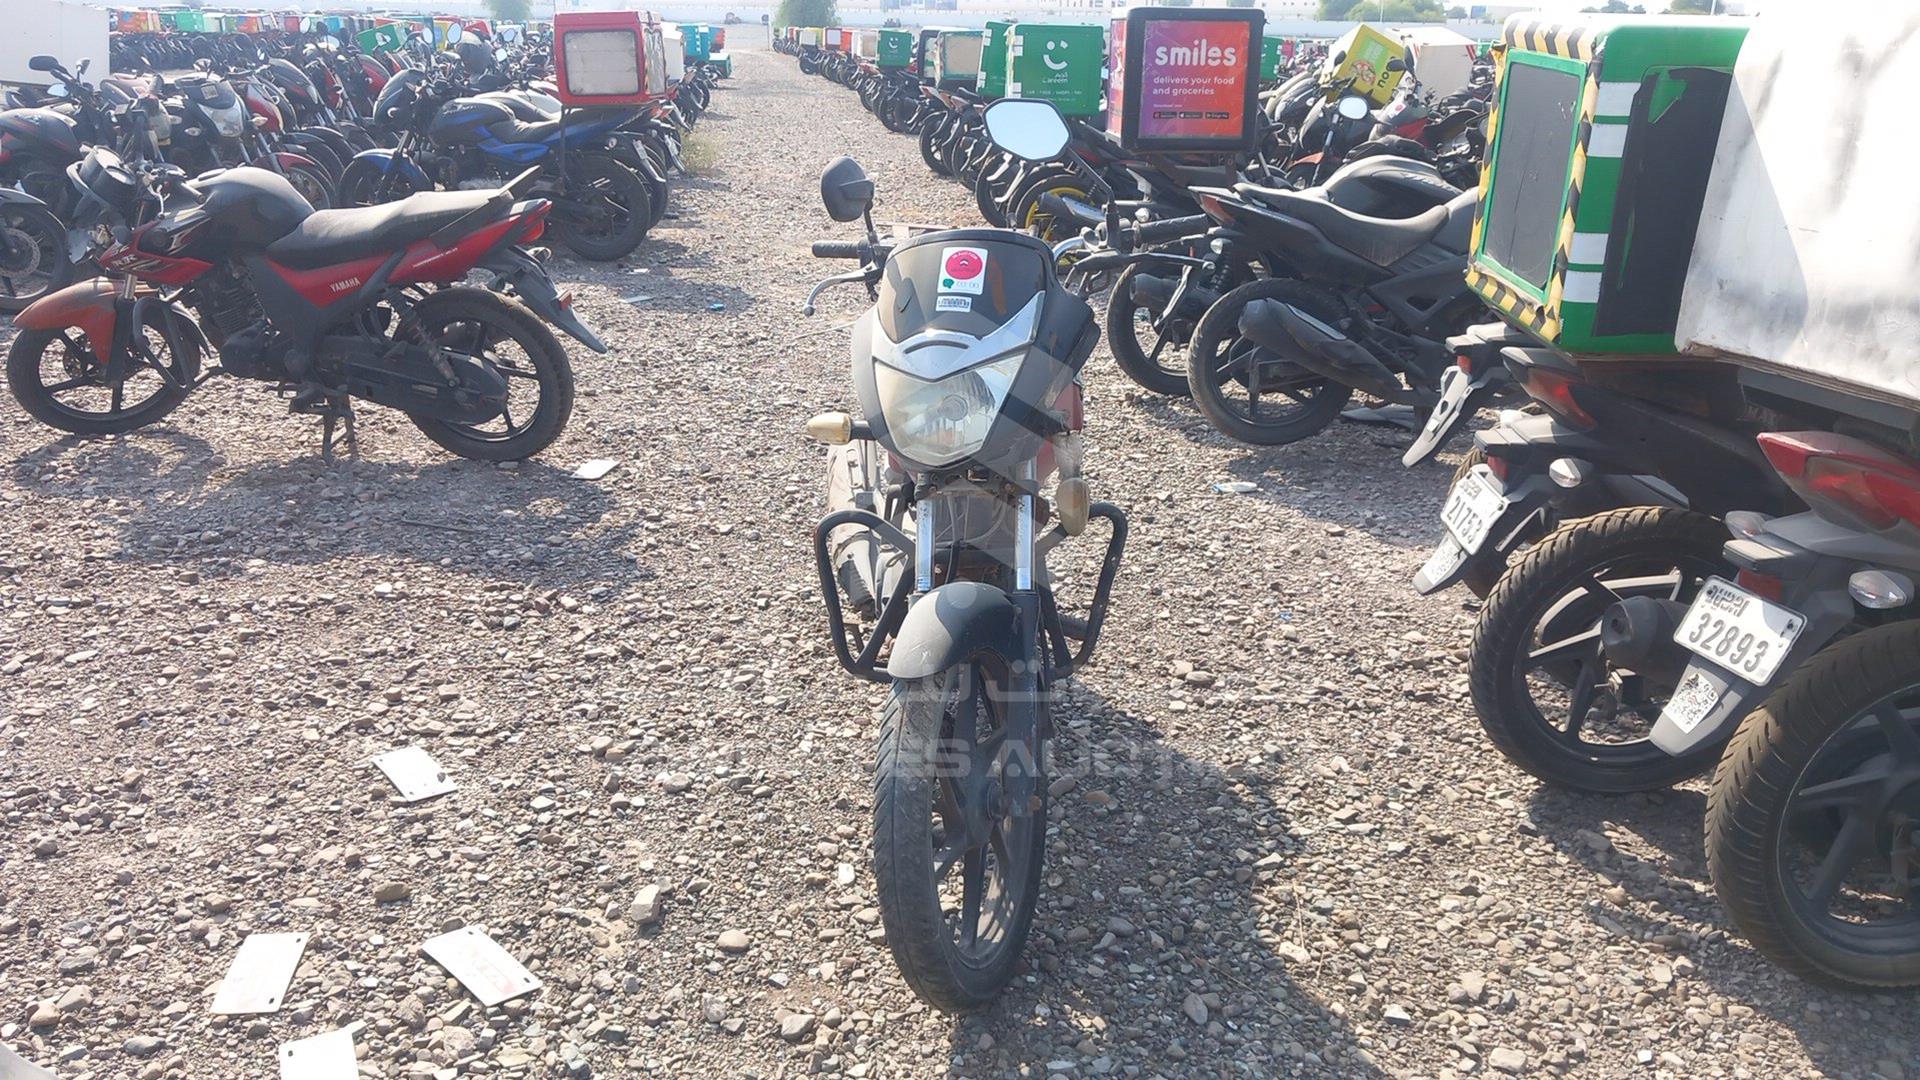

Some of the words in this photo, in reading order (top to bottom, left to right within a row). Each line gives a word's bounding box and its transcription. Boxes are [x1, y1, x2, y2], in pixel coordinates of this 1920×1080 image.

[1154, 38, 1237, 67] smiles
[1152, 86, 1171, 95] and
[1172, 86, 1215, 97] groceries
[1153, 75, 1189, 85] delivers
[1191, 77, 1212, 86] your
[1213, 76, 1235, 85] food
[329, 277, 361, 293] YAMAHA
[1446, 495, 1483, 544] 21753
[1688, 612, 1769, 673] 32893
